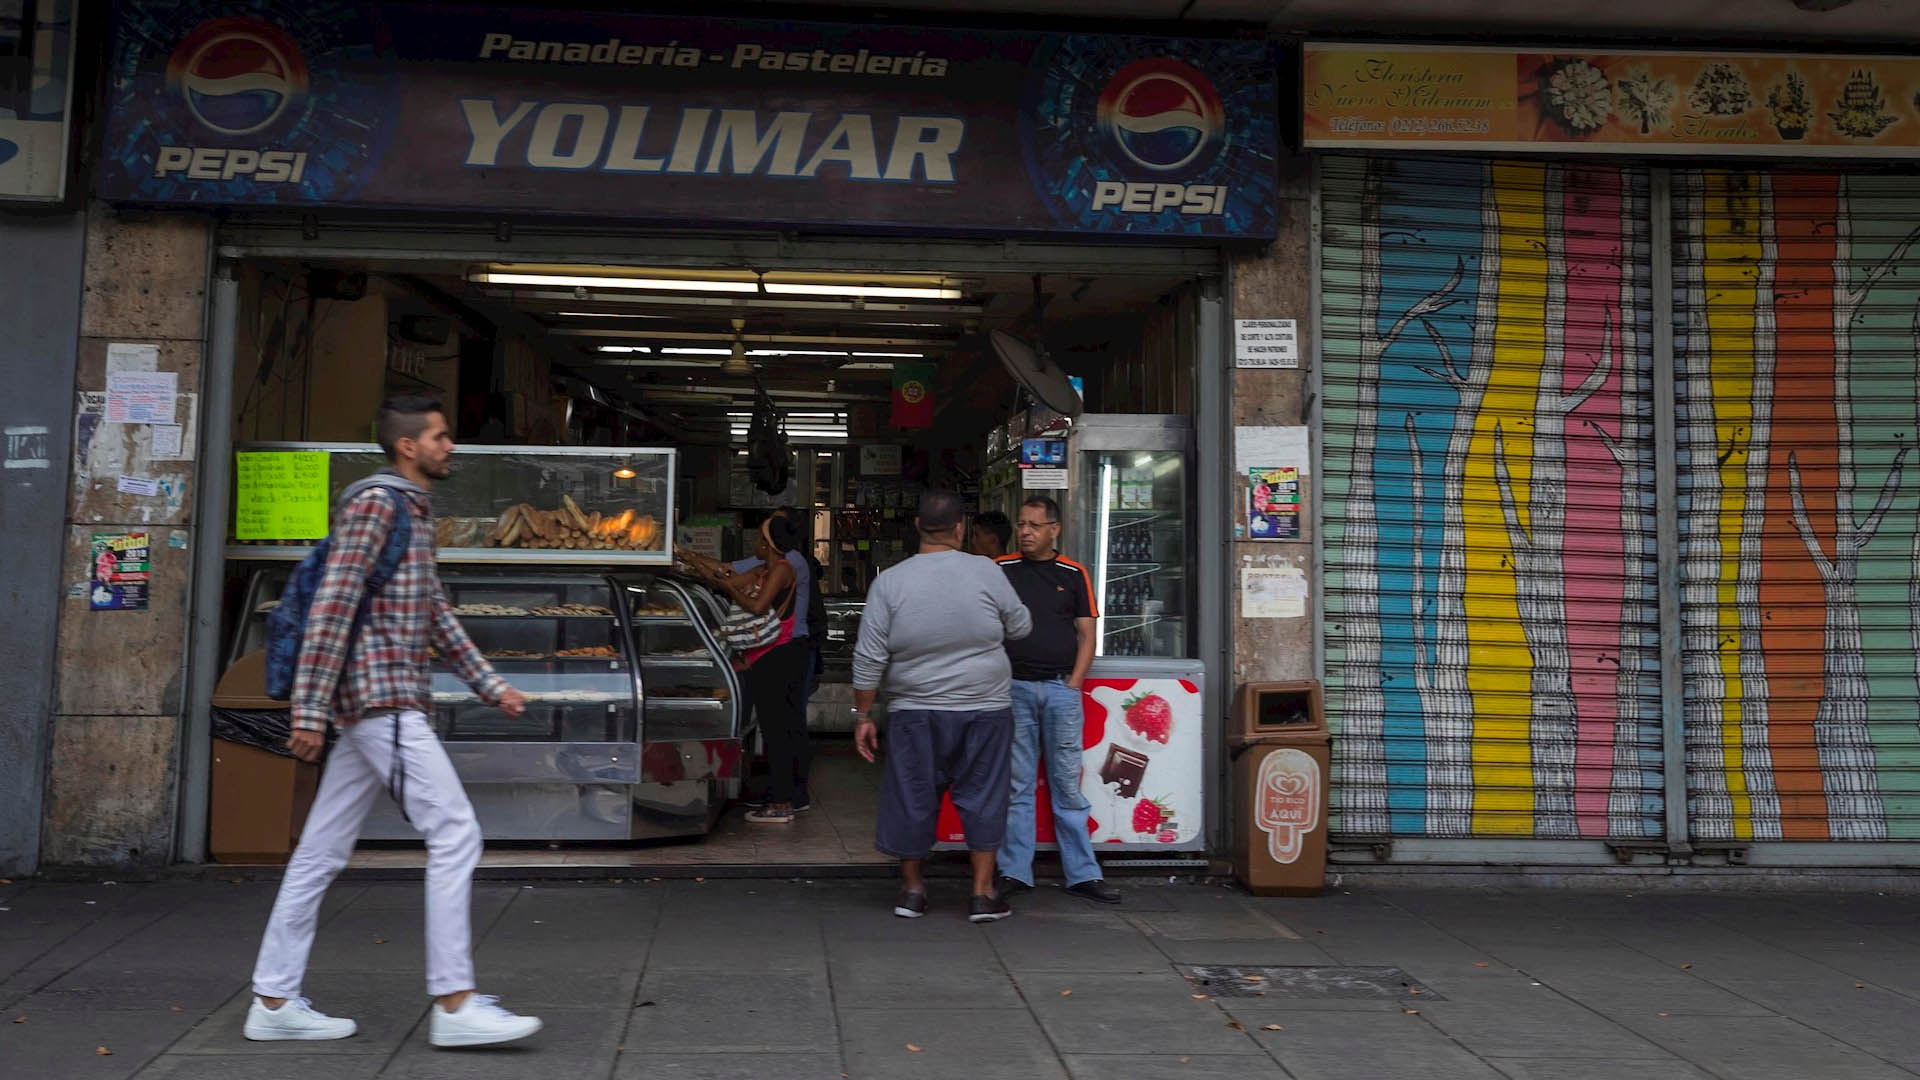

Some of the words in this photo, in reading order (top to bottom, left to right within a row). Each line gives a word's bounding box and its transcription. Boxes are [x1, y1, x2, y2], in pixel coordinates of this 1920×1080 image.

[479, 32, 698, 68] Panadería
[731, 43, 949, 79] Pastelería
[463, 99, 961, 184] YOLIMAR
[155, 146, 308, 184] PEPSI
[1091, 181, 1227, 217] PEPSI
